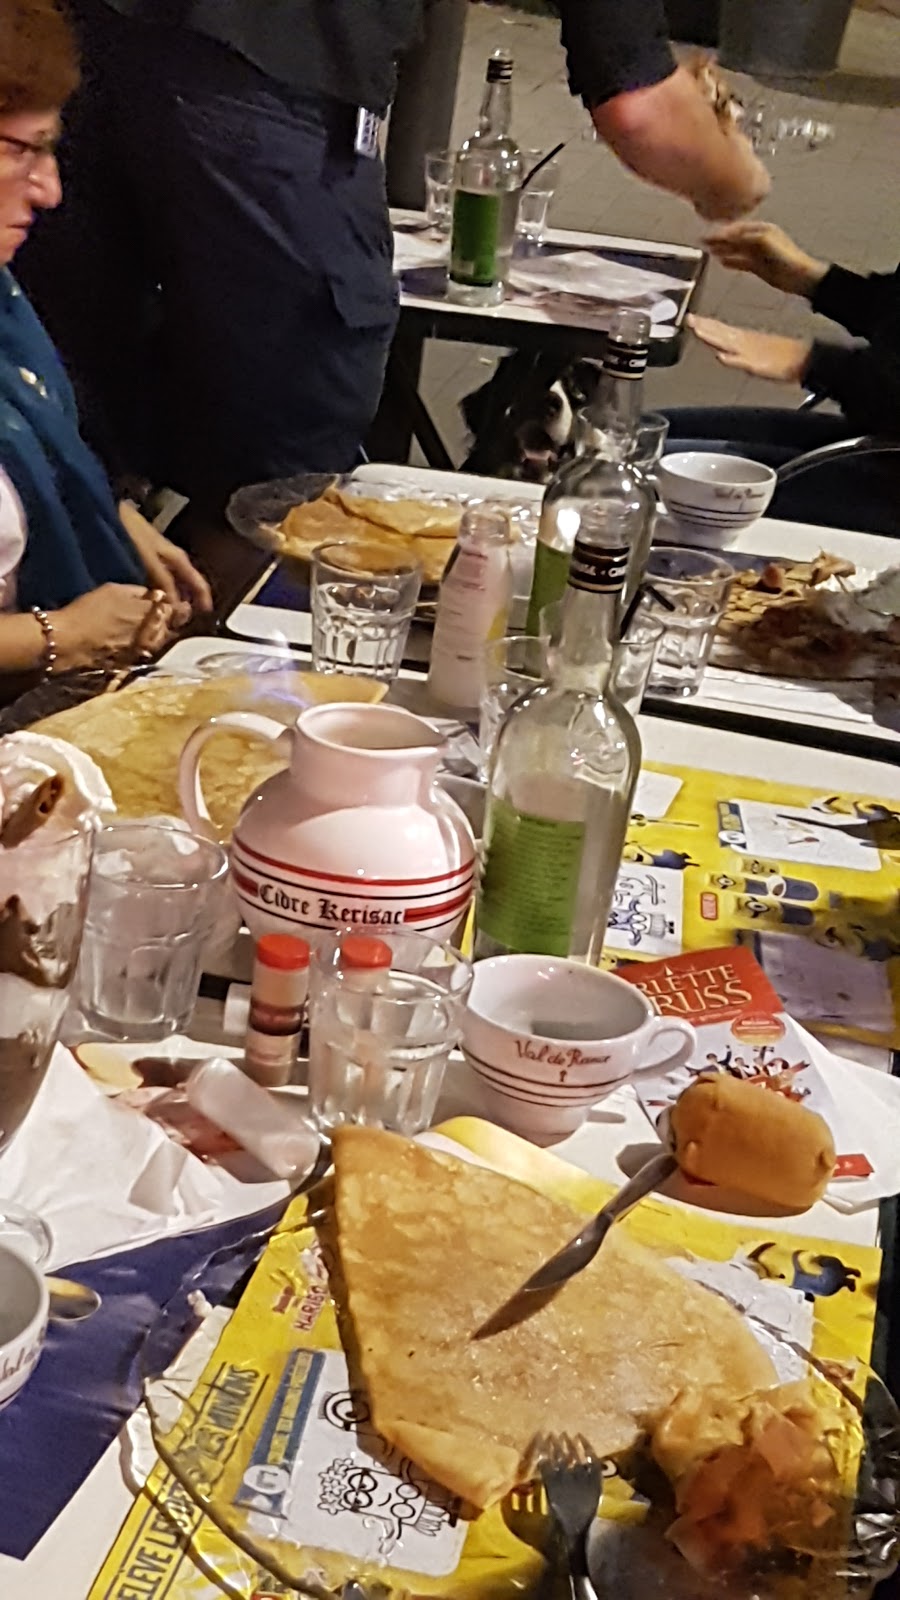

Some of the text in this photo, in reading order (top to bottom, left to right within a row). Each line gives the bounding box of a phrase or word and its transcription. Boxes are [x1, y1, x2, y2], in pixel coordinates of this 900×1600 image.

[259, 883, 403, 926] Cidre Kerisac
[514, 1040, 549, 1062] Val
[293, 1285, 327, 1333] HARIBO
